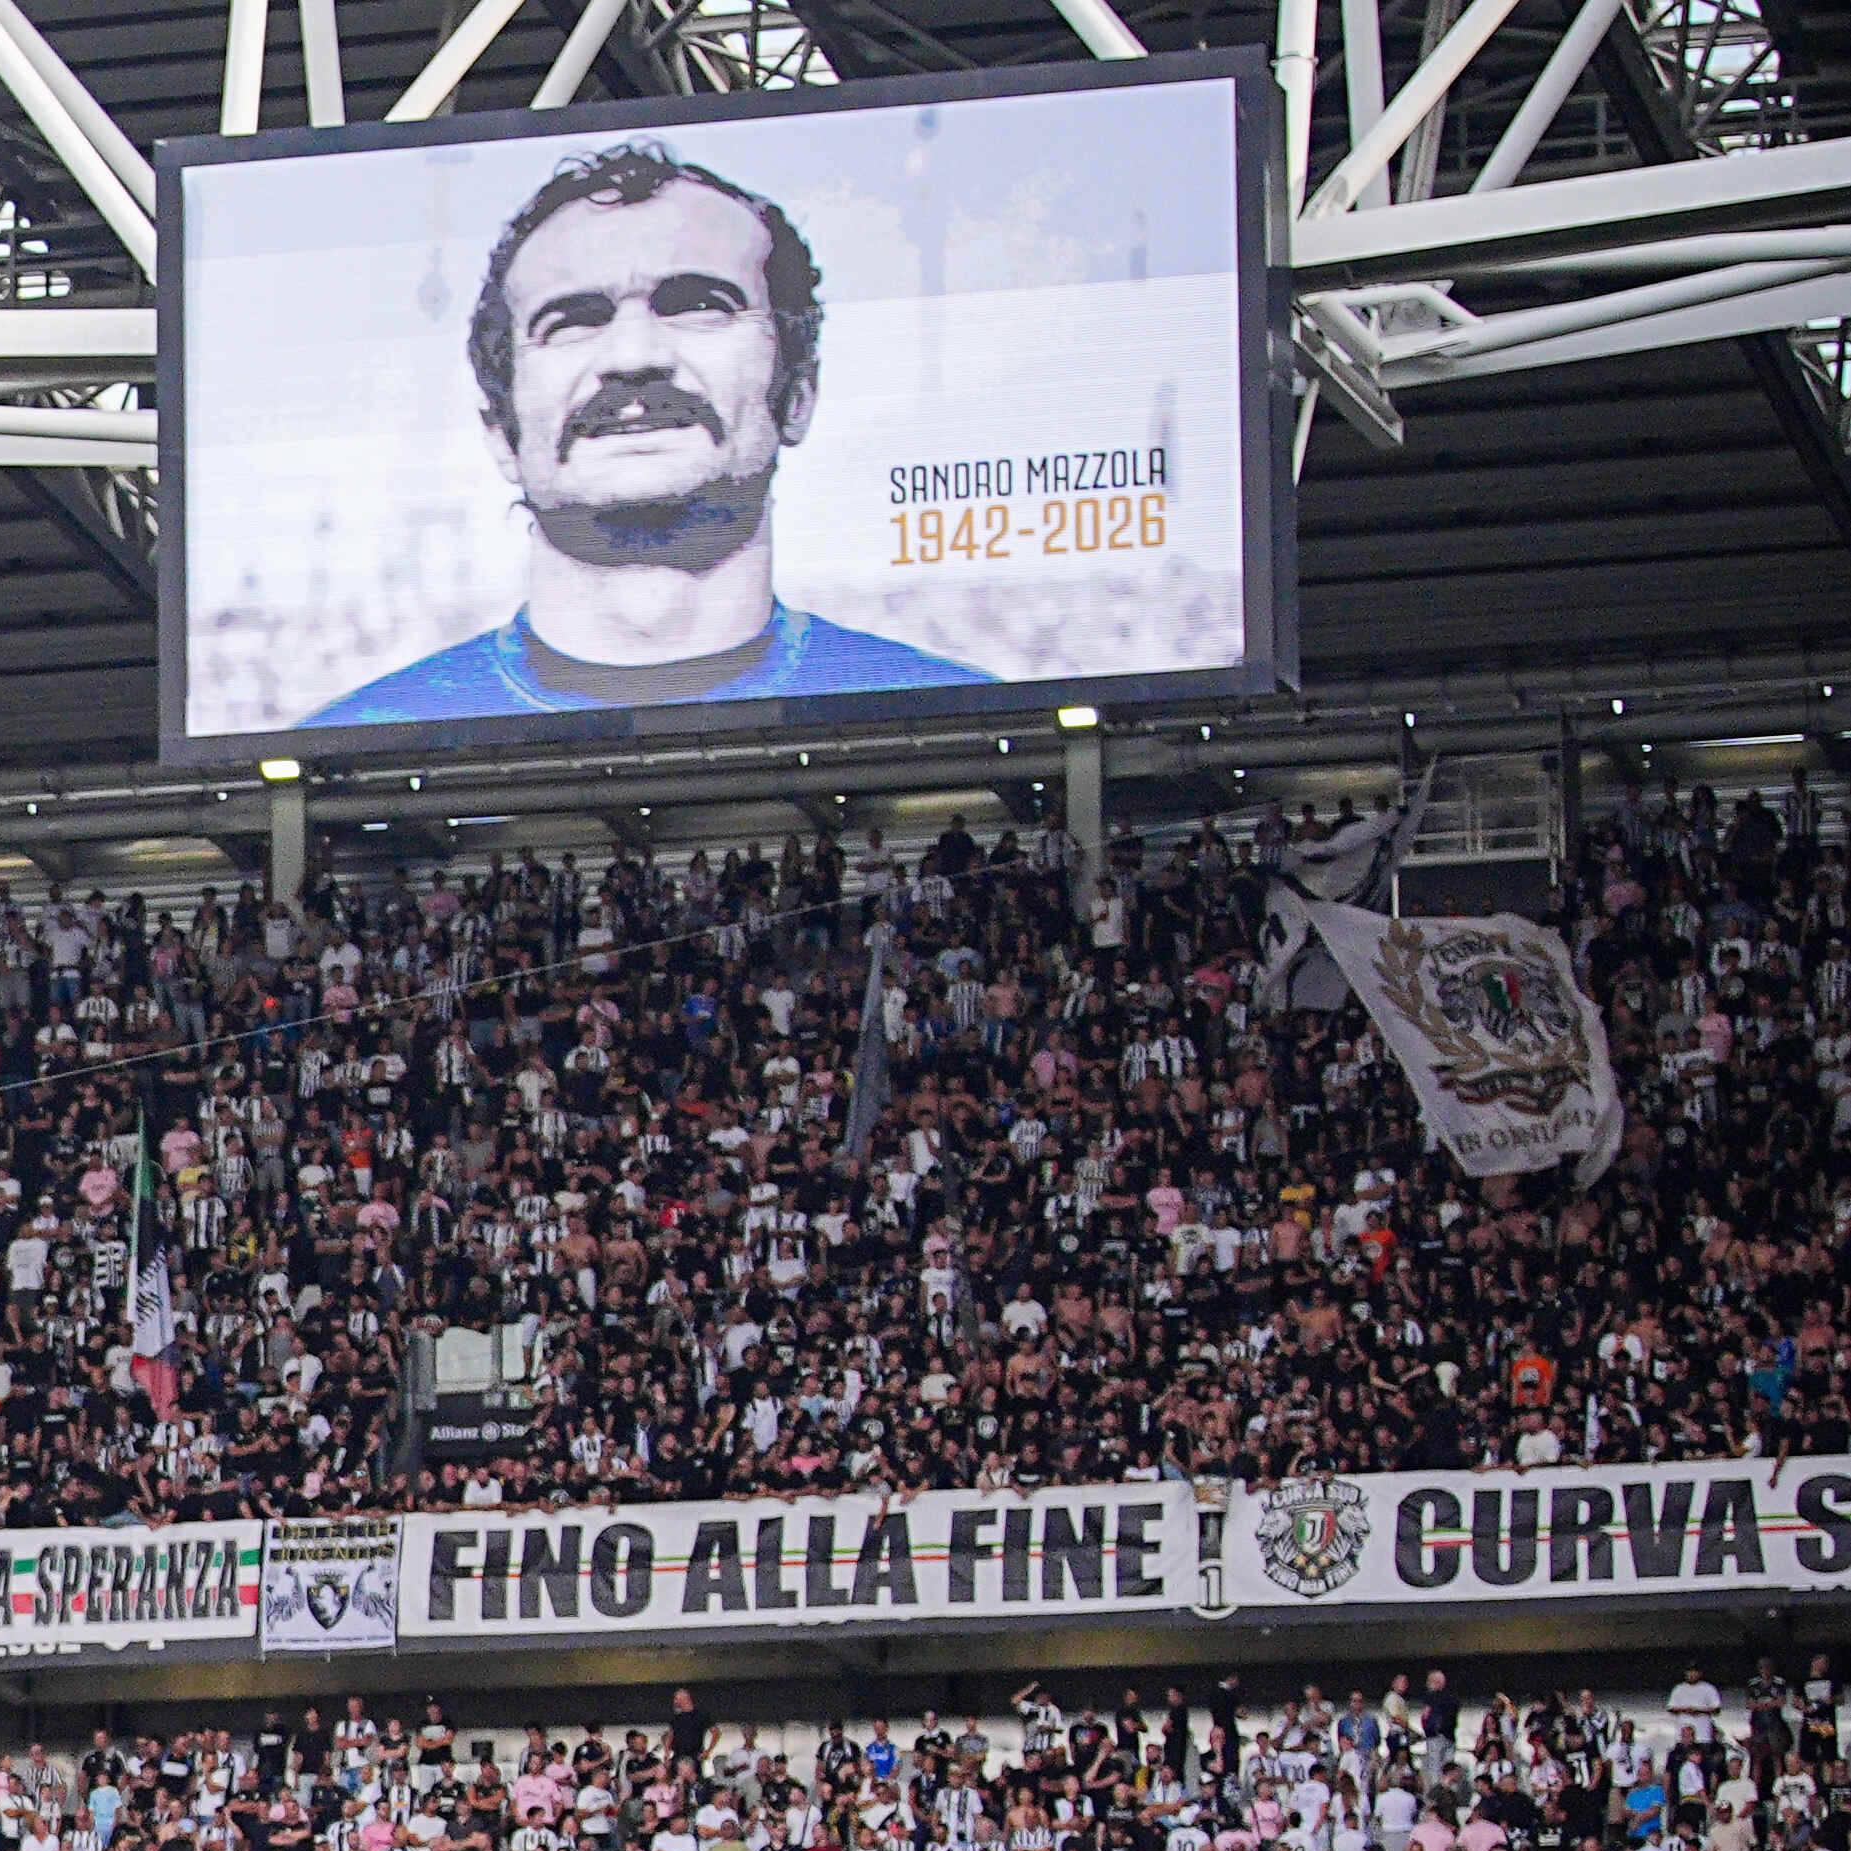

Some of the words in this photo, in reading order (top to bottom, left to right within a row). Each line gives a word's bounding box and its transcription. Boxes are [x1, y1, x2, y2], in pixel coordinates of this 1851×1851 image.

[890, 459, 1011, 505] SANDRO
[1027, 447, 1166, 494] MAZZOLA
[890, 494, 1166, 565] 1942-2026
[431, 1426, 479, 1440] Allianz
[428, 1522, 654, 1621] FINO
[682, 1511, 916, 1613] ALLA
[948, 1504, 1164, 1603] FINE
[1395, 1480, 1765, 1588] CURVA
[34, 1540, 241, 1625] SPERANZA
